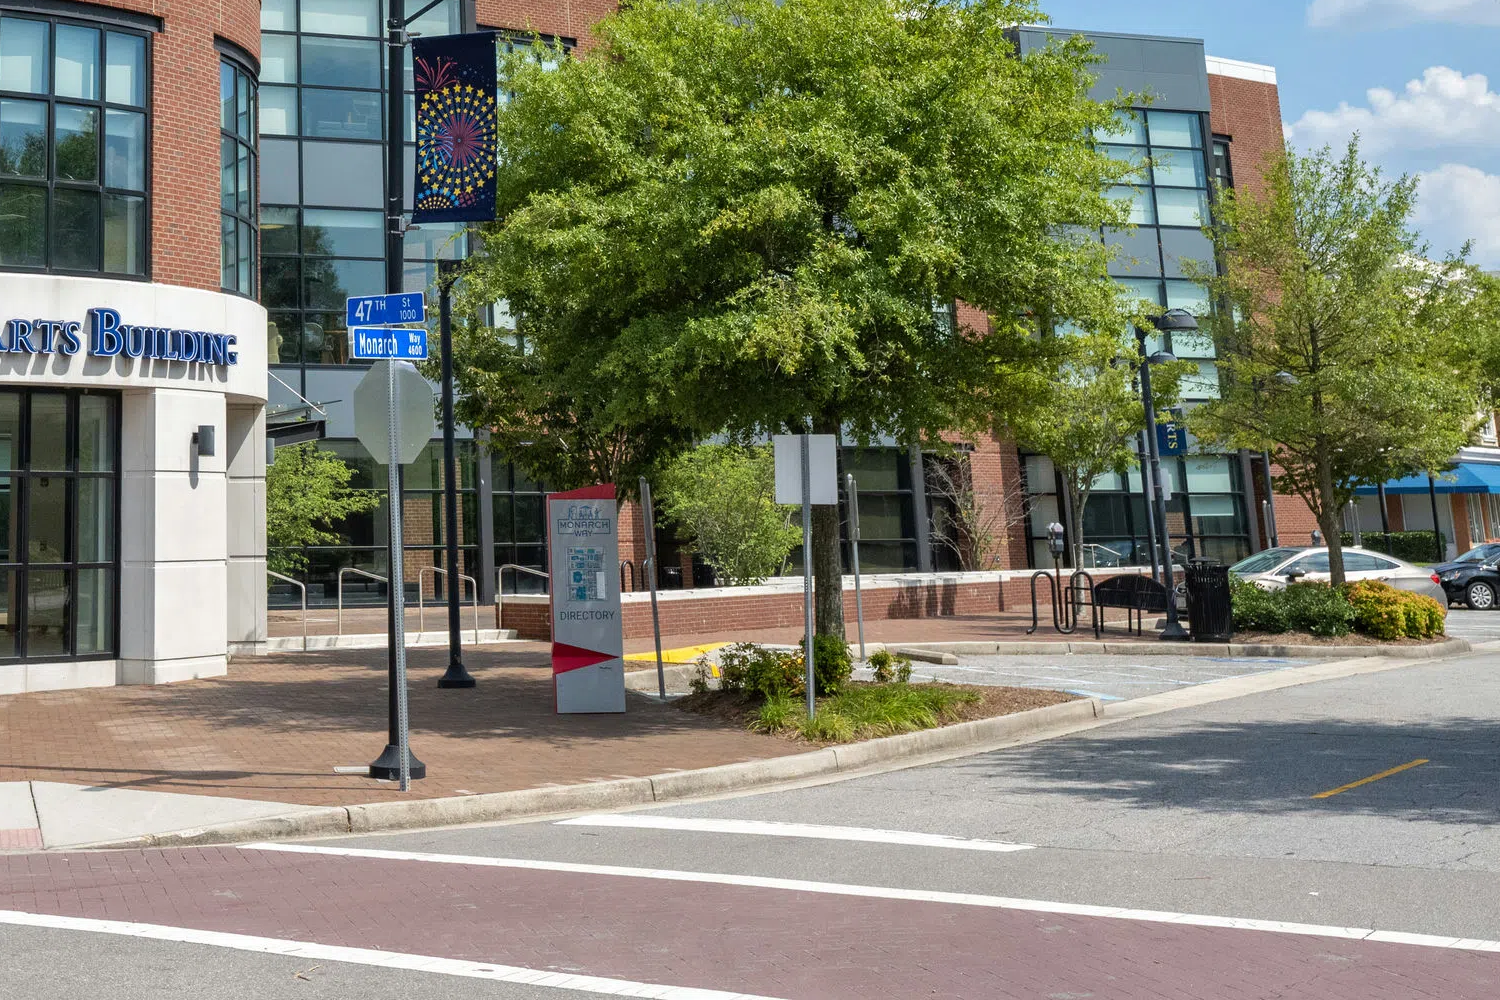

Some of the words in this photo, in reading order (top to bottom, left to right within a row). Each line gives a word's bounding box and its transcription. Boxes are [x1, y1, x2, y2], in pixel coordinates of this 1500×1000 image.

[402, 297, 411, 308] St
[399, 309, 417, 321] 1000
[87, 307, 238, 366] BUILDING
[359, 332, 398, 355] Monarch
[408, 332, 421, 344] Way
[408, 345, 423, 356] 4600
[1166, 422, 1178, 449] RTS
[559, 521, 609, 529] MONARCH
[573, 529, 593, 537] WAY
[560, 610, 615, 621] DIRECTORY
